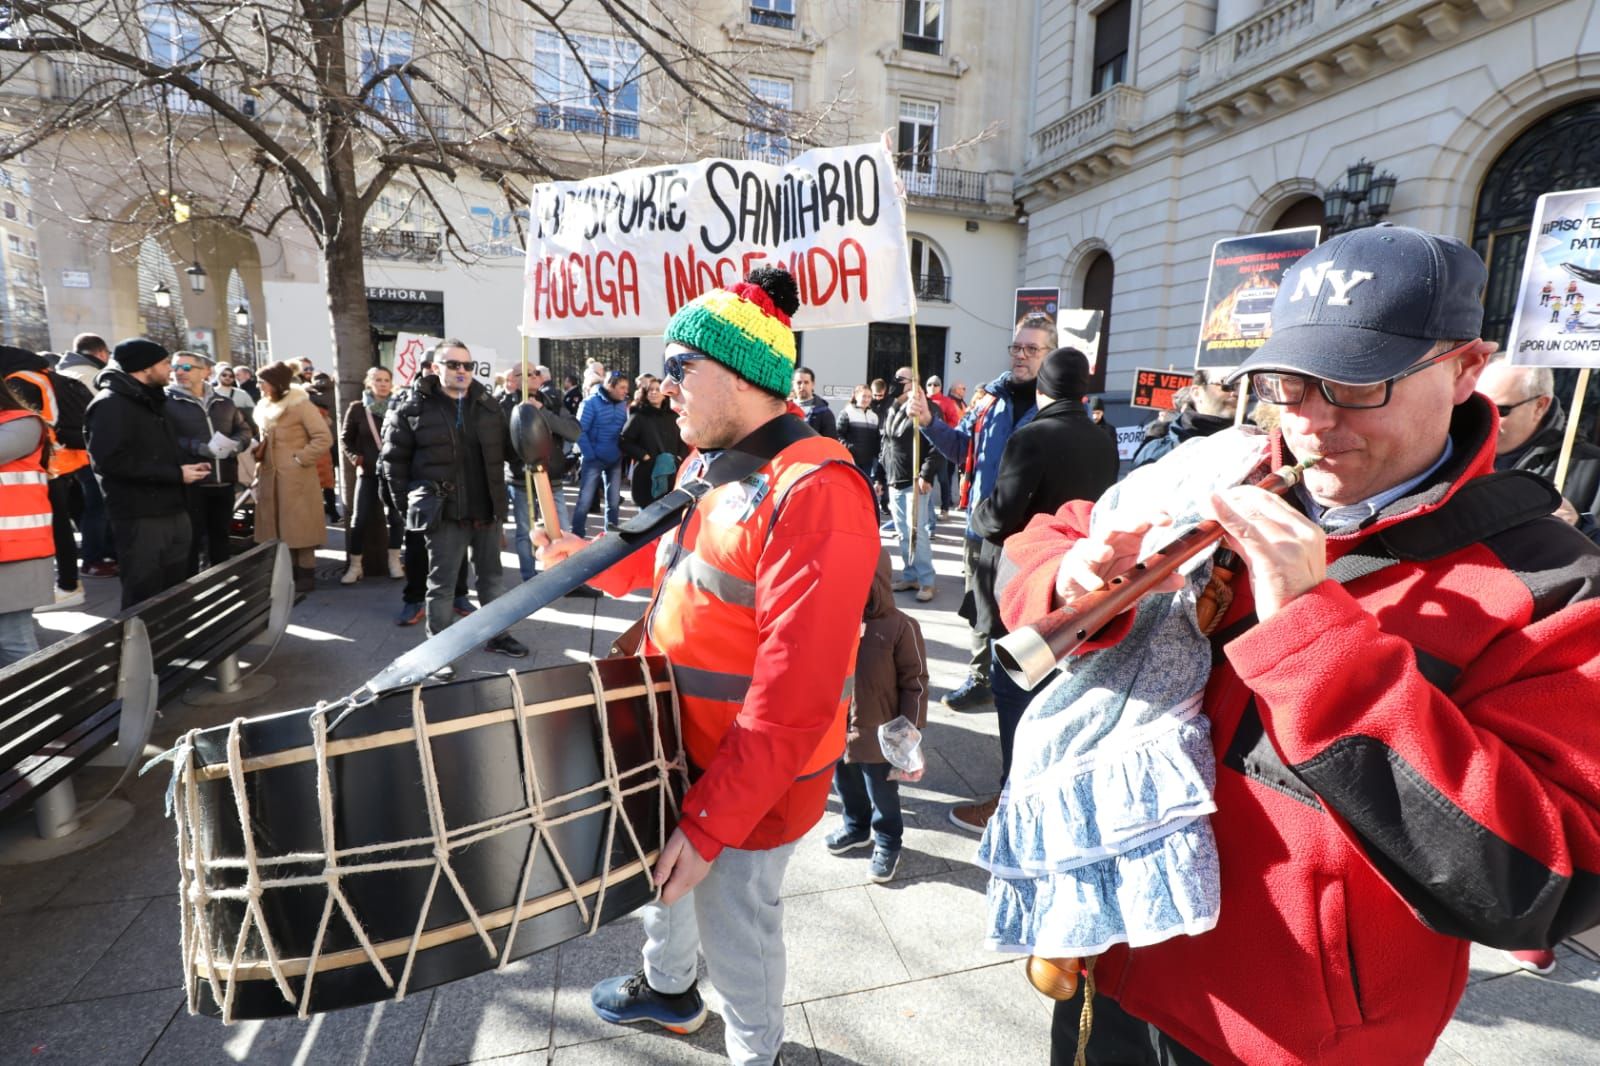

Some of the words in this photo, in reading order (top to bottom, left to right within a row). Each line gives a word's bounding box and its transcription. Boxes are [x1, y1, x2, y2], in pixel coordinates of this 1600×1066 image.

[700, 153, 880, 254] SANITARIO
[534, 249, 640, 321] HUELGA
[1290, 260, 1375, 306] NY
[365, 288, 427, 300] EPHORA
[1546, 340, 1561, 351] UN
[1563, 340, 1600, 351] CONVE
[954, 352, 962, 364] 3
[1139, 372, 1157, 386] SE
